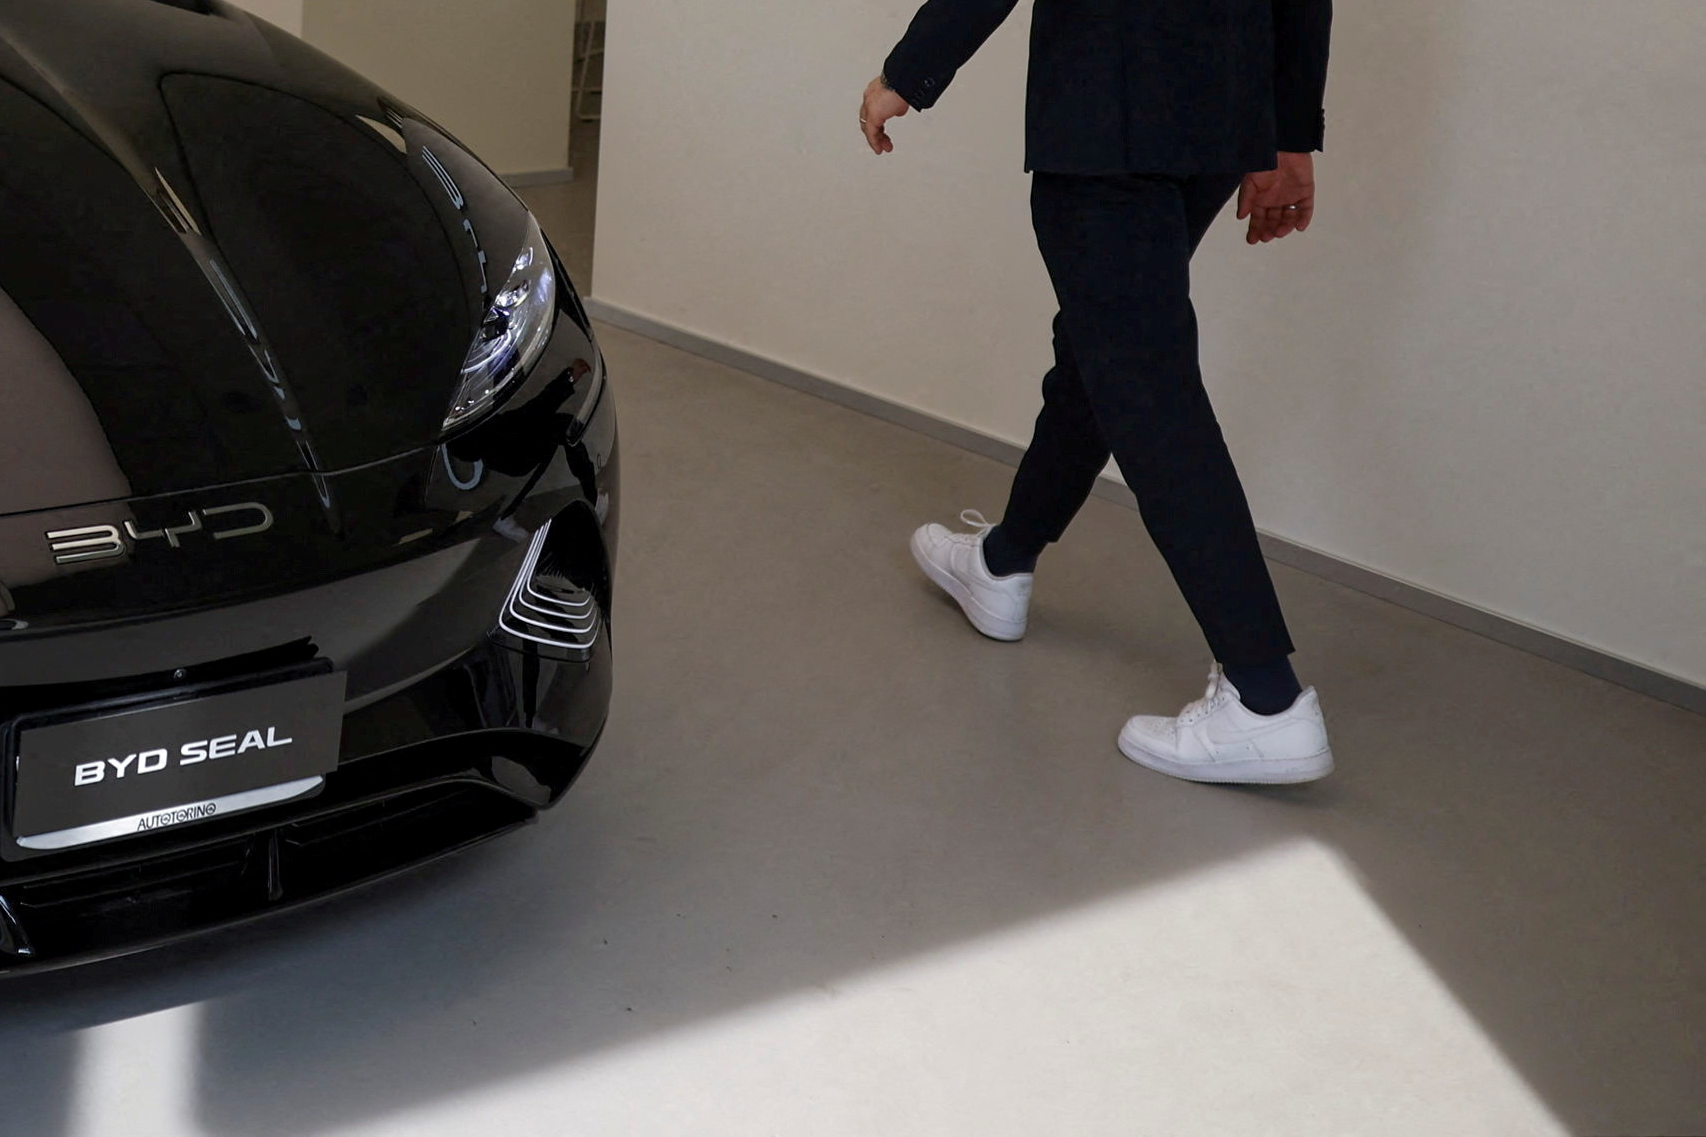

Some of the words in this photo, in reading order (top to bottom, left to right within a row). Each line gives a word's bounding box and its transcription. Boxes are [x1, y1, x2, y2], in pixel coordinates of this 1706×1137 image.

[46, 501, 275, 564] BYD
[73, 748, 169, 787] BYD
[179, 726, 293, 767] SEAL
[136, 802, 217, 832] AUTOTORINO
